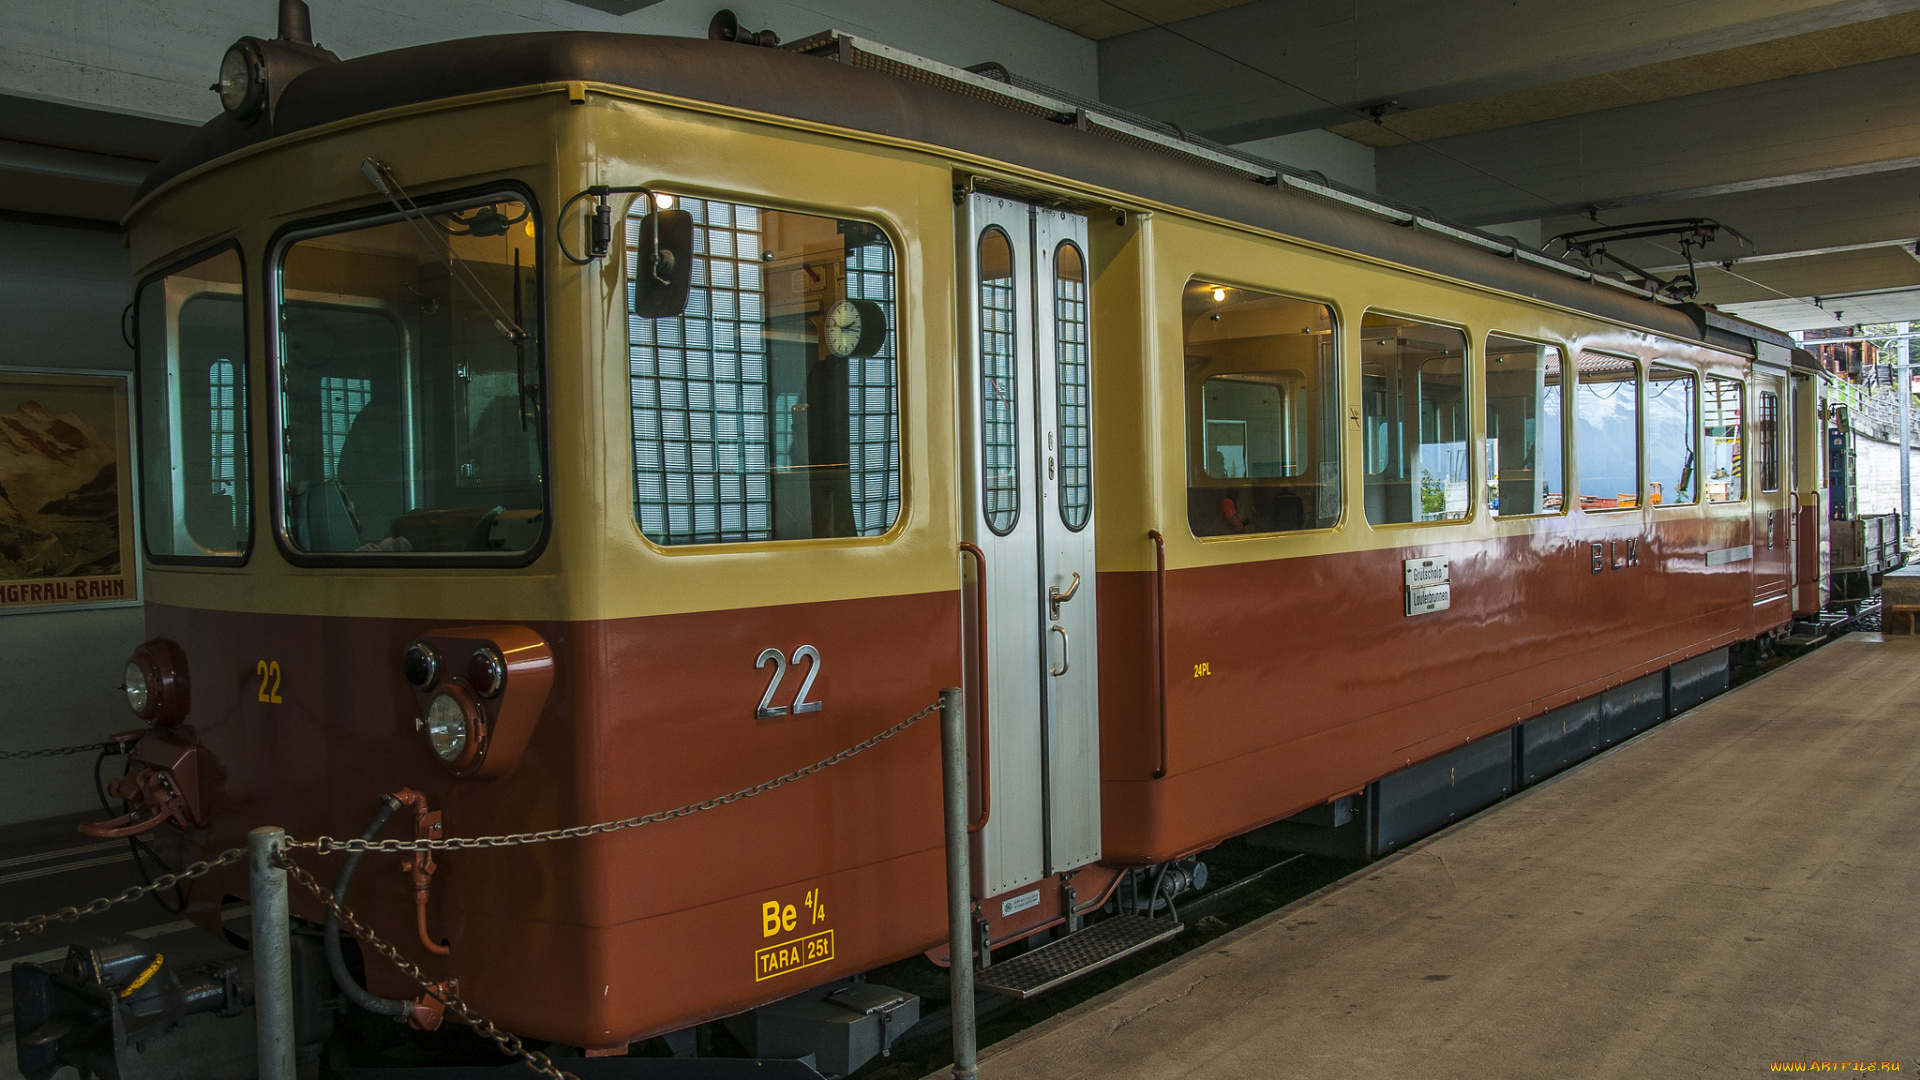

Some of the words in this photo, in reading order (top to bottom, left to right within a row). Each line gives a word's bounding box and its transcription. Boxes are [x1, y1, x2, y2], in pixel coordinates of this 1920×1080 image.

[256, 659, 282, 704] 22
[755, 644, 822, 719] 22
[1193, 662, 1211, 678] 24PL
[762, 900, 797, 938] Be
[804, 888, 825, 925] 4/4
[760, 946, 800, 973] TARA
[807, 938, 829, 960] 25t
